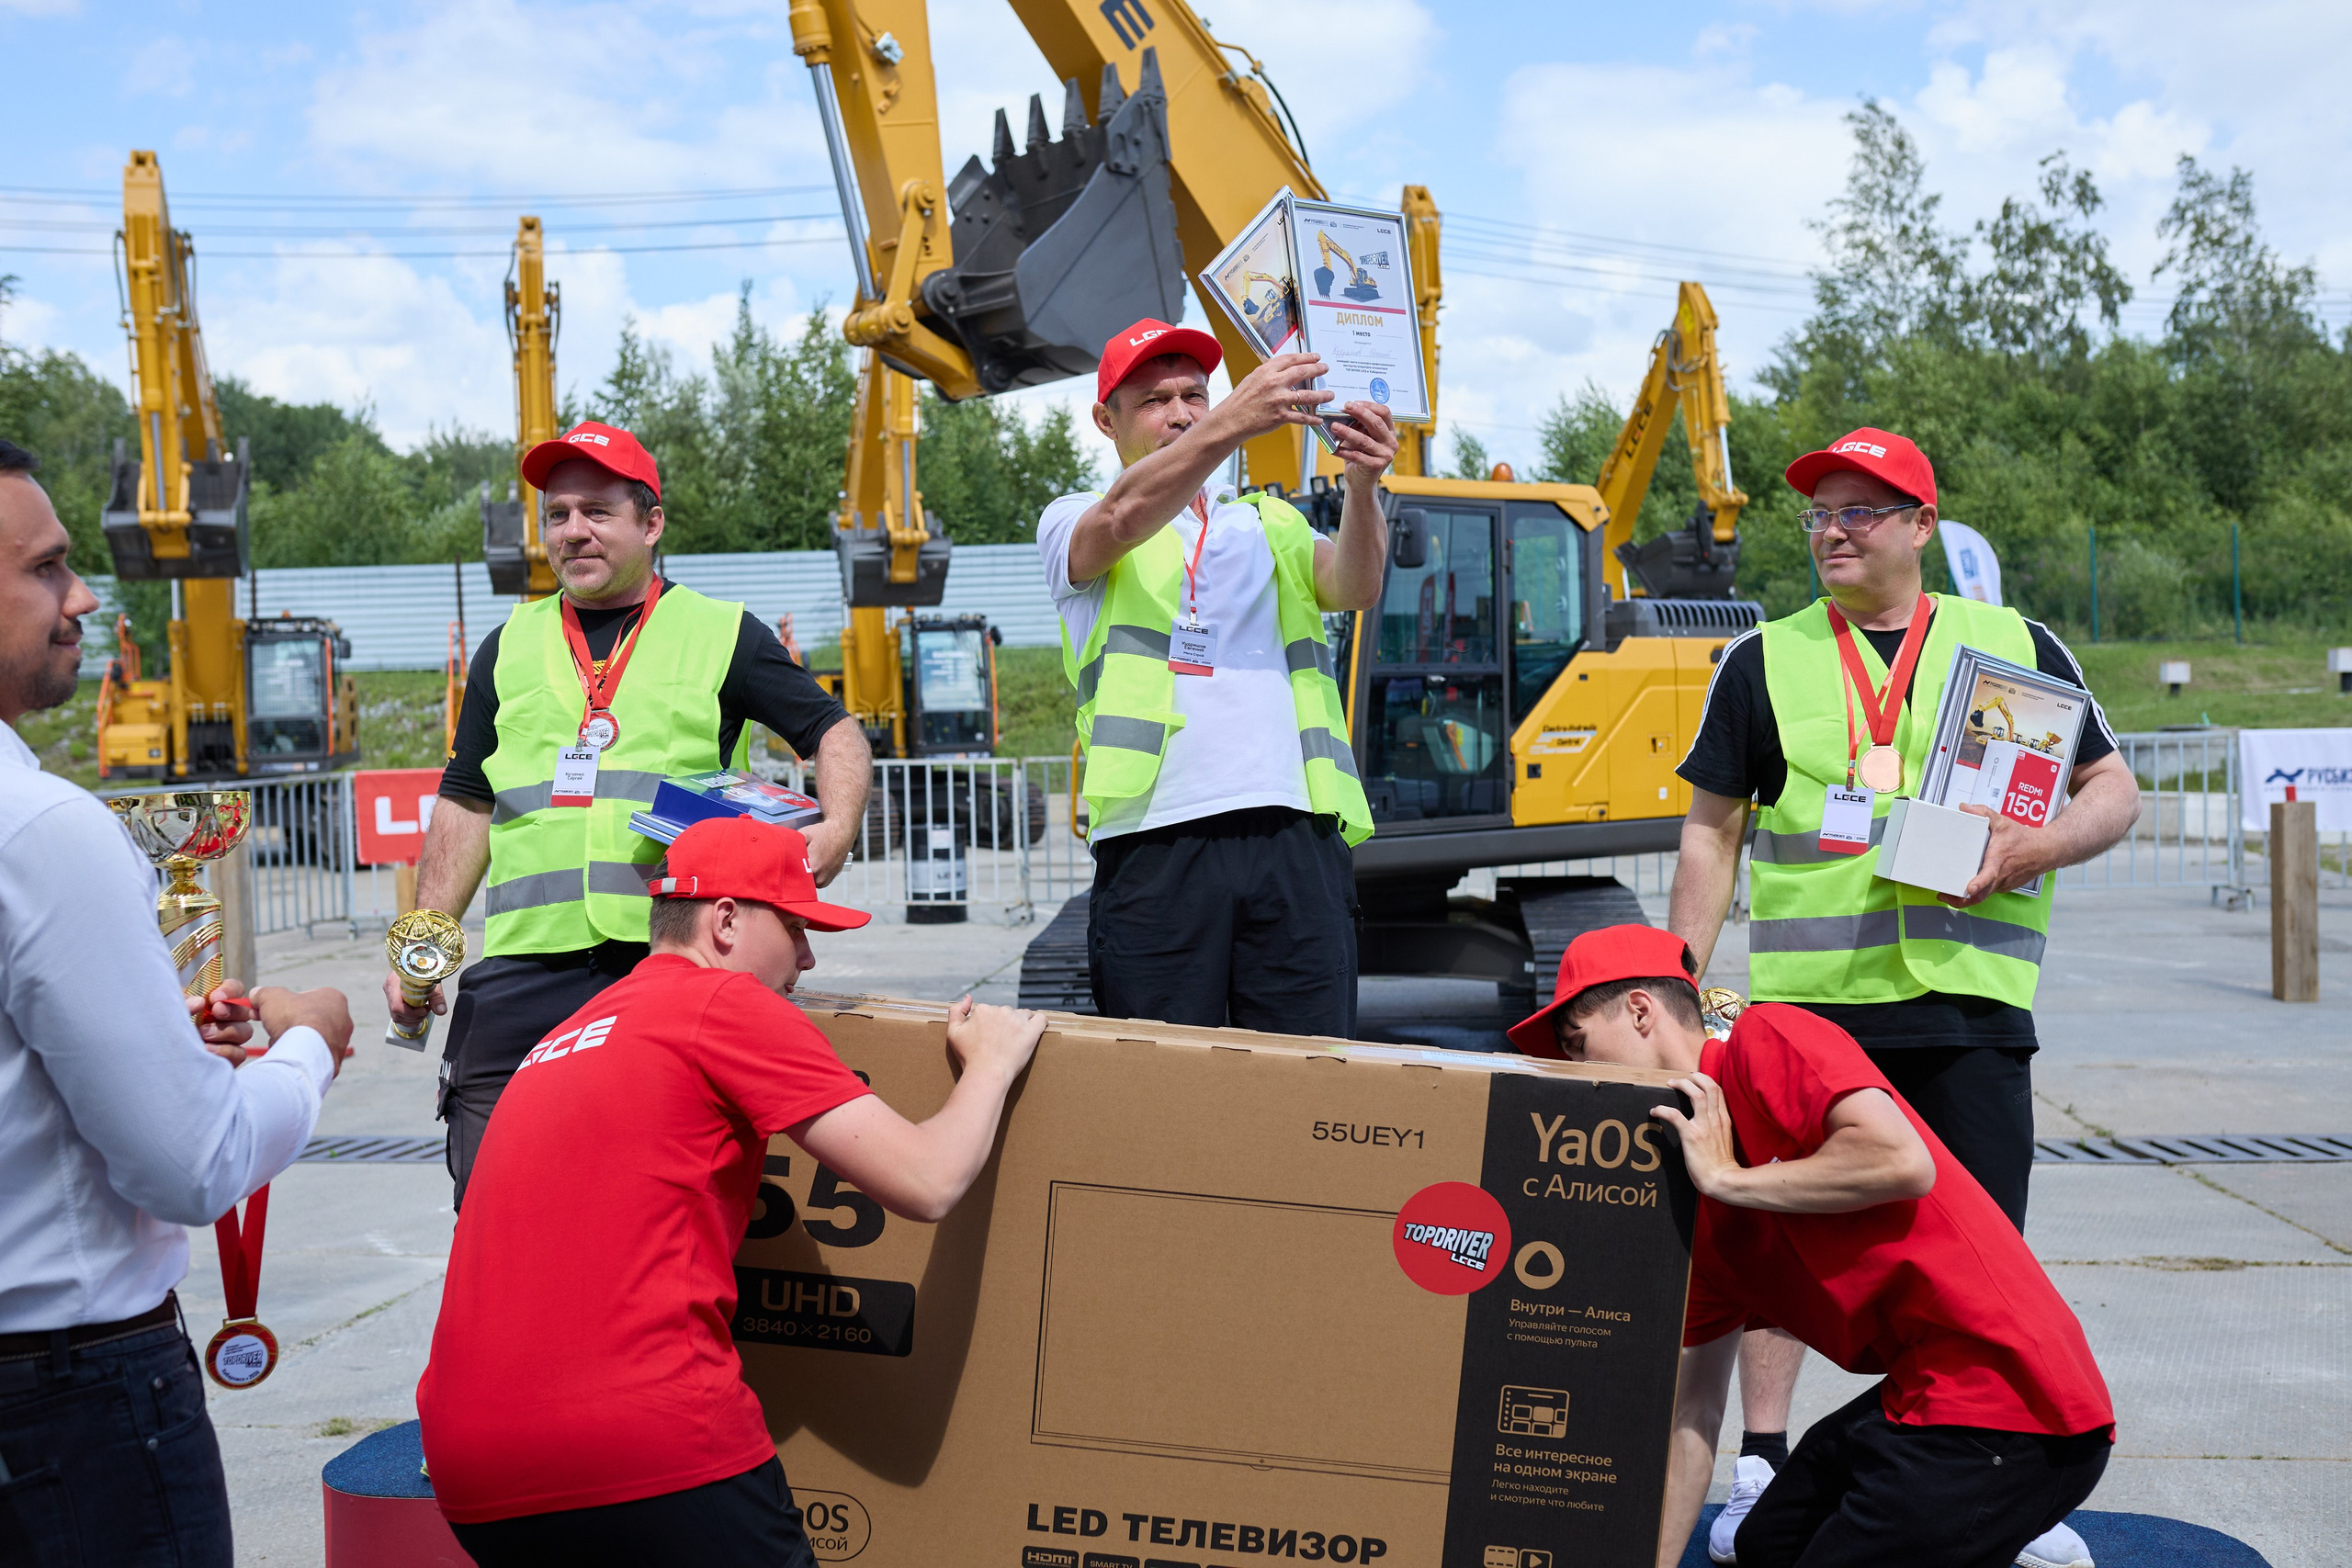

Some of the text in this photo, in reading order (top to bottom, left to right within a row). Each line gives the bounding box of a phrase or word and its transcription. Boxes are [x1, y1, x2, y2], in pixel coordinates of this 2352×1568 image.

[1336, 311, 1384, 327] ДИПЛОМ
[1179, 626, 1209, 634] LGCE
[1834, 794, 1867, 803] LGCE
[2018, 782, 2043, 797] REDMI
[2007, 792, 2046, 821] 15C
[1312, 1121, 1424, 1149] 55UEY1
[1530, 1112, 1663, 1172] YaOS
[1522, 1174, 1657, 1208] с Алисой
[1404, 1223, 1494, 1260] TOPDRIVER
[761, 1278, 861, 1318] UHD
[1510, 1299, 1565, 1317] Внутри
[1585, 1305, 1631, 1322] Алиса
[1509, 1318, 1611, 1337] Управляйте голосом
[1514, 1334, 1563, 1345] помощью
[1565, 1337, 1599, 1348] пульта
[223, 1350, 263, 1366] TOPDRIVER
[1495, 1443, 1612, 1467] Все интересное
[1494, 1462, 1618, 1483] на одном экране
[1492, 1479, 1569, 1495] Легко находите
[1498, 1495, 1546, 1506] смотрите
[1566, 1501, 1605, 1512] любите
[1027, 1503, 1387, 1565] LED ТЕЛЕВИЗОР
[1027, 1551, 1072, 1564] HDMI
